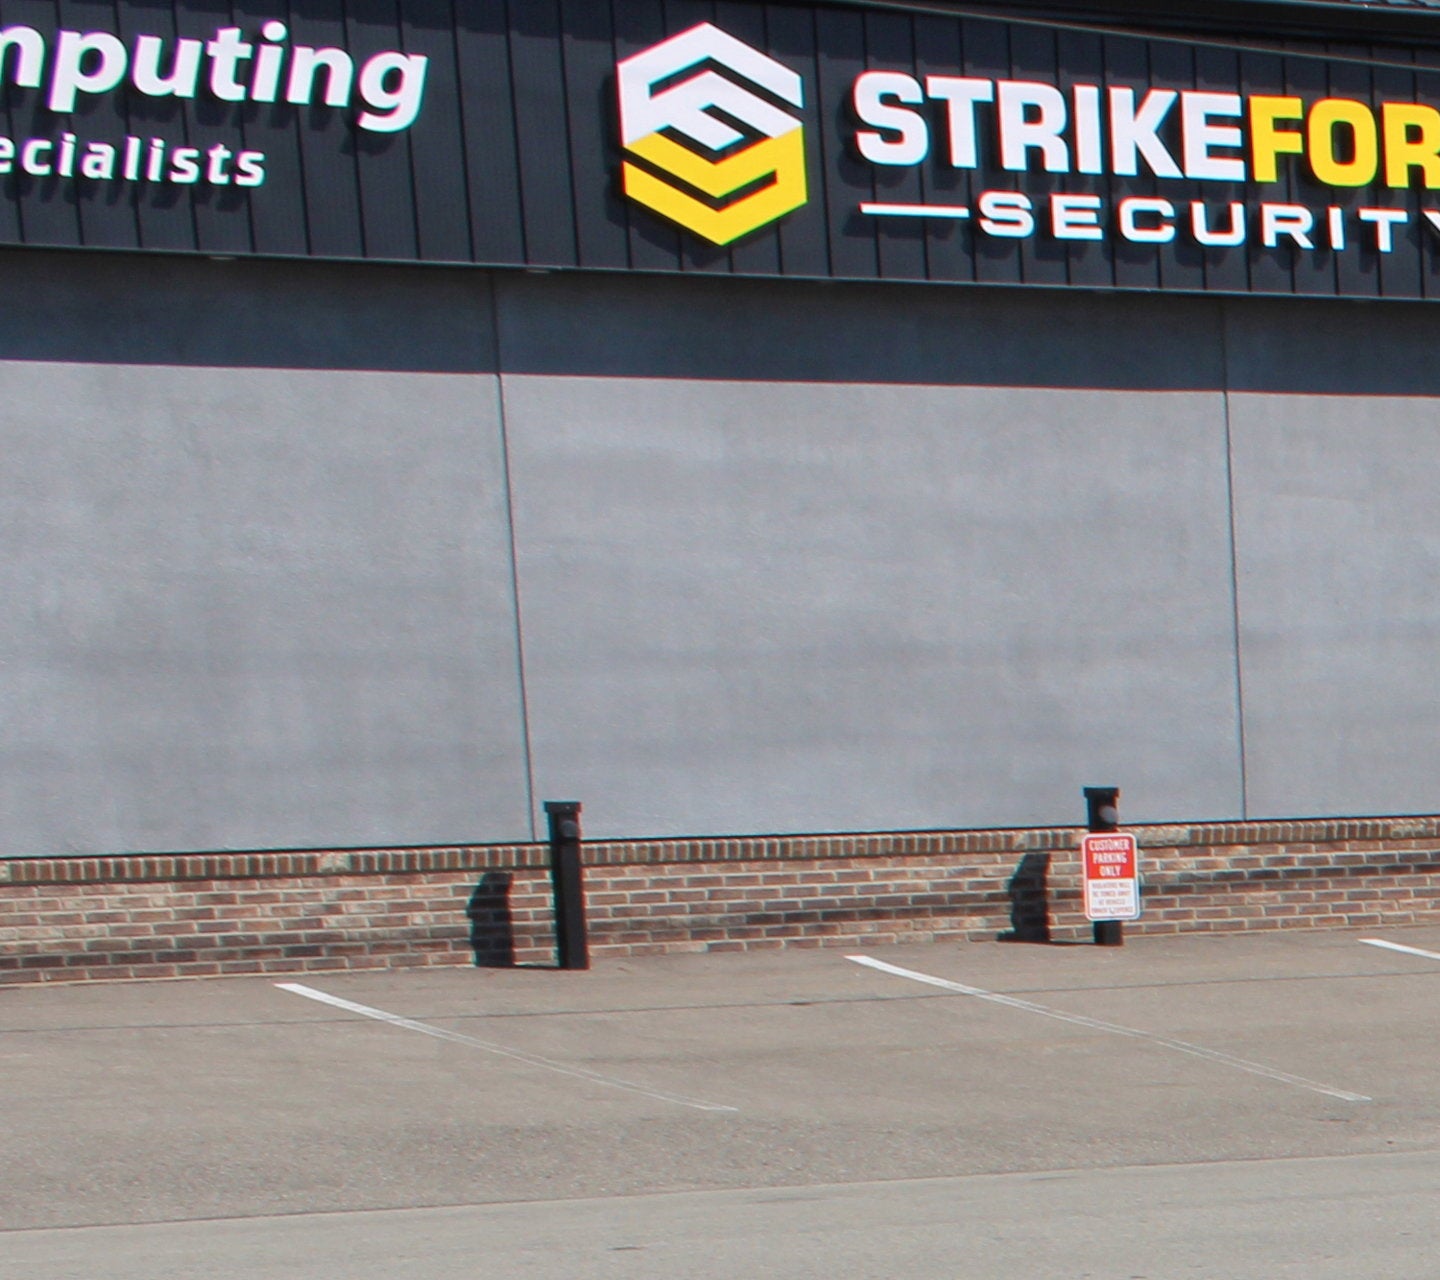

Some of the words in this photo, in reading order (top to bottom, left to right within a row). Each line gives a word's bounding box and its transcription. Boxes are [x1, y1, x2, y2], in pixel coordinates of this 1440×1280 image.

[1089, 838, 1131, 851] CUSTOMER
[1092, 852, 1128, 864] PARKING
[1099, 865, 1122, 877] ONLY
